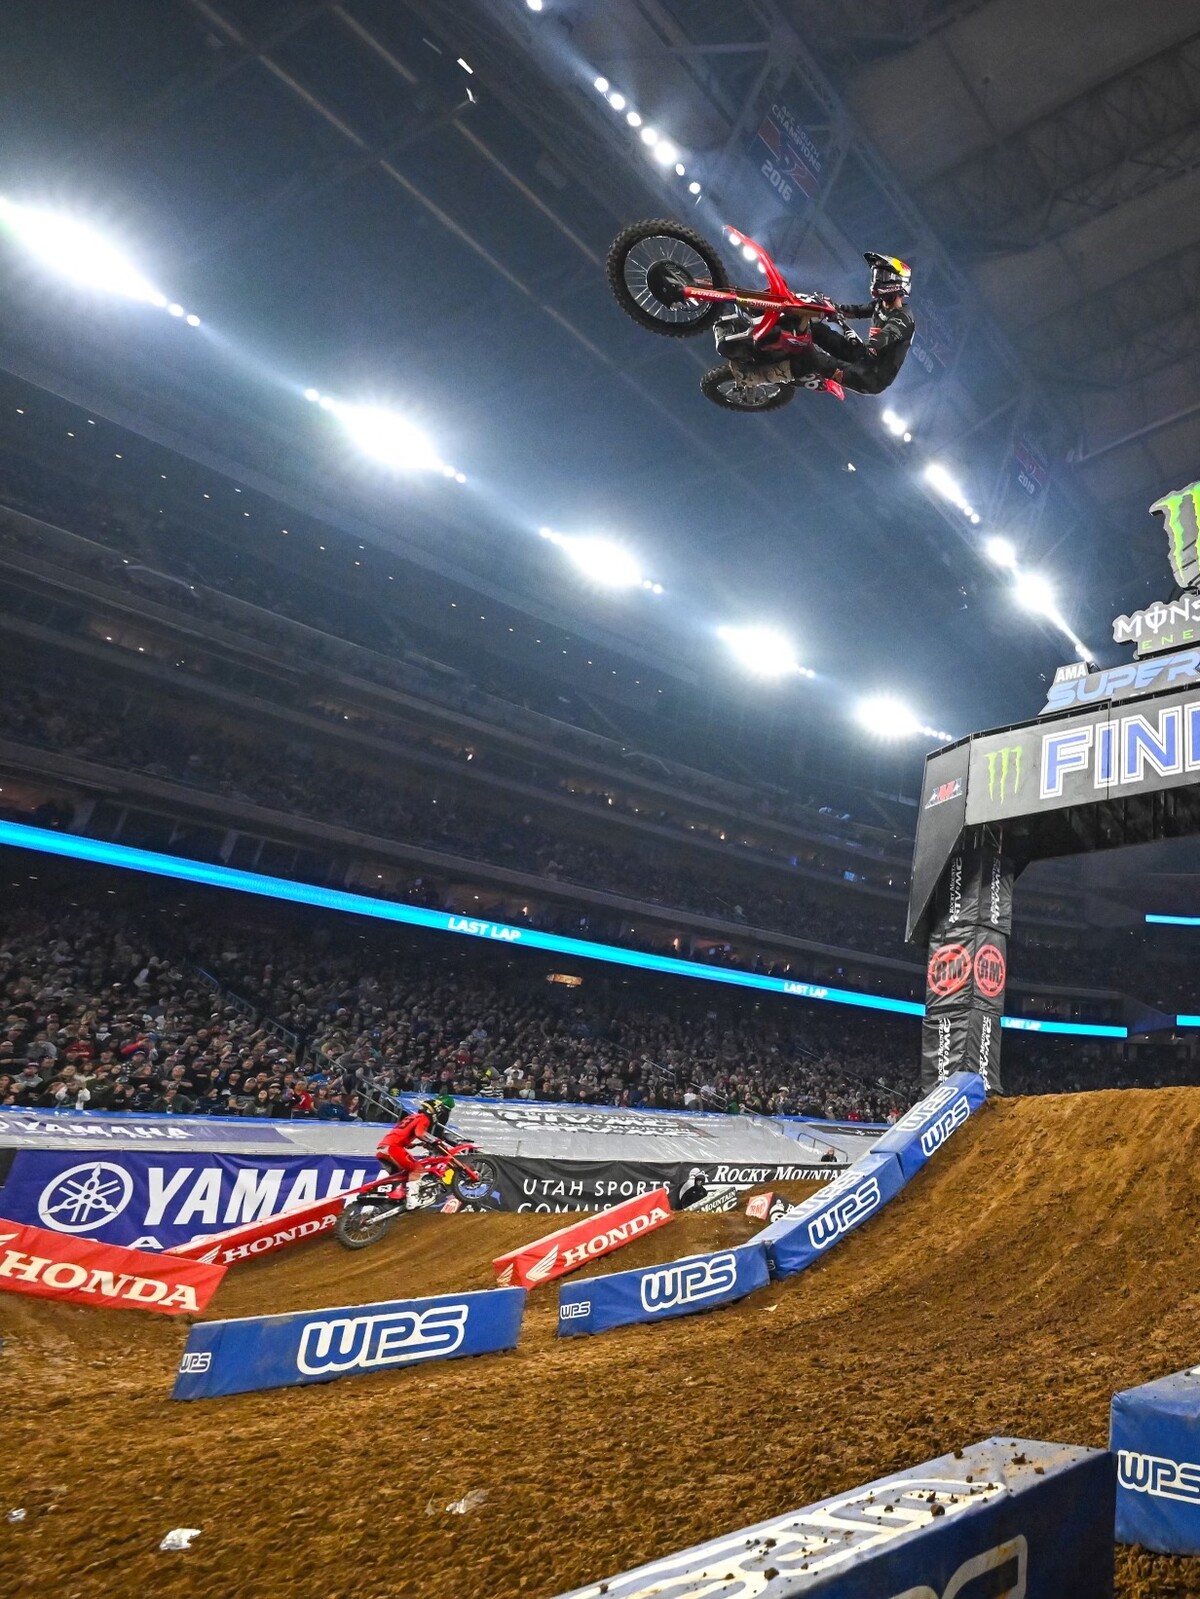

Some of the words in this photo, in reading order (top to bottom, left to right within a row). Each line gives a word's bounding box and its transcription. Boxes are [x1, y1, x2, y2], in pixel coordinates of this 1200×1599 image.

[772, 104, 821, 172] CHAMPIONS
[761, 160, 793, 201] 2016
[1018, 471, 1035, 494] 2019
[1056, 664, 1087, 684] AMA
[448, 917, 489, 936] LAST
[490, 926, 521, 941] LAP
[13, 1120, 194, 1139] YAMAHA
[920, 1095, 971, 1157] WPS
[712, 1165, 772, 1183] ROCKY
[773, 1166, 843, 1181] MOUNTA
[523, 1179, 585, 1196] UTAH
[595, 1180, 671, 1196] SPORTS
[517, 1202, 612, 1214] COMMIS
[701, 1189, 737, 1212] MOUNTAIN
[808, 1177, 881, 1249] WPS
[223, 1213, 337, 1263] HONDA
[562, 1207, 670, 1266] HONDA
[0, 1250, 200, 1311] HONDA
[640, 1254, 737, 1312] WPS
[560, 1301, 591, 1320] WPS
[297, 1304, 469, 1375] WPS
[180, 1352, 211, 1374] WPS
